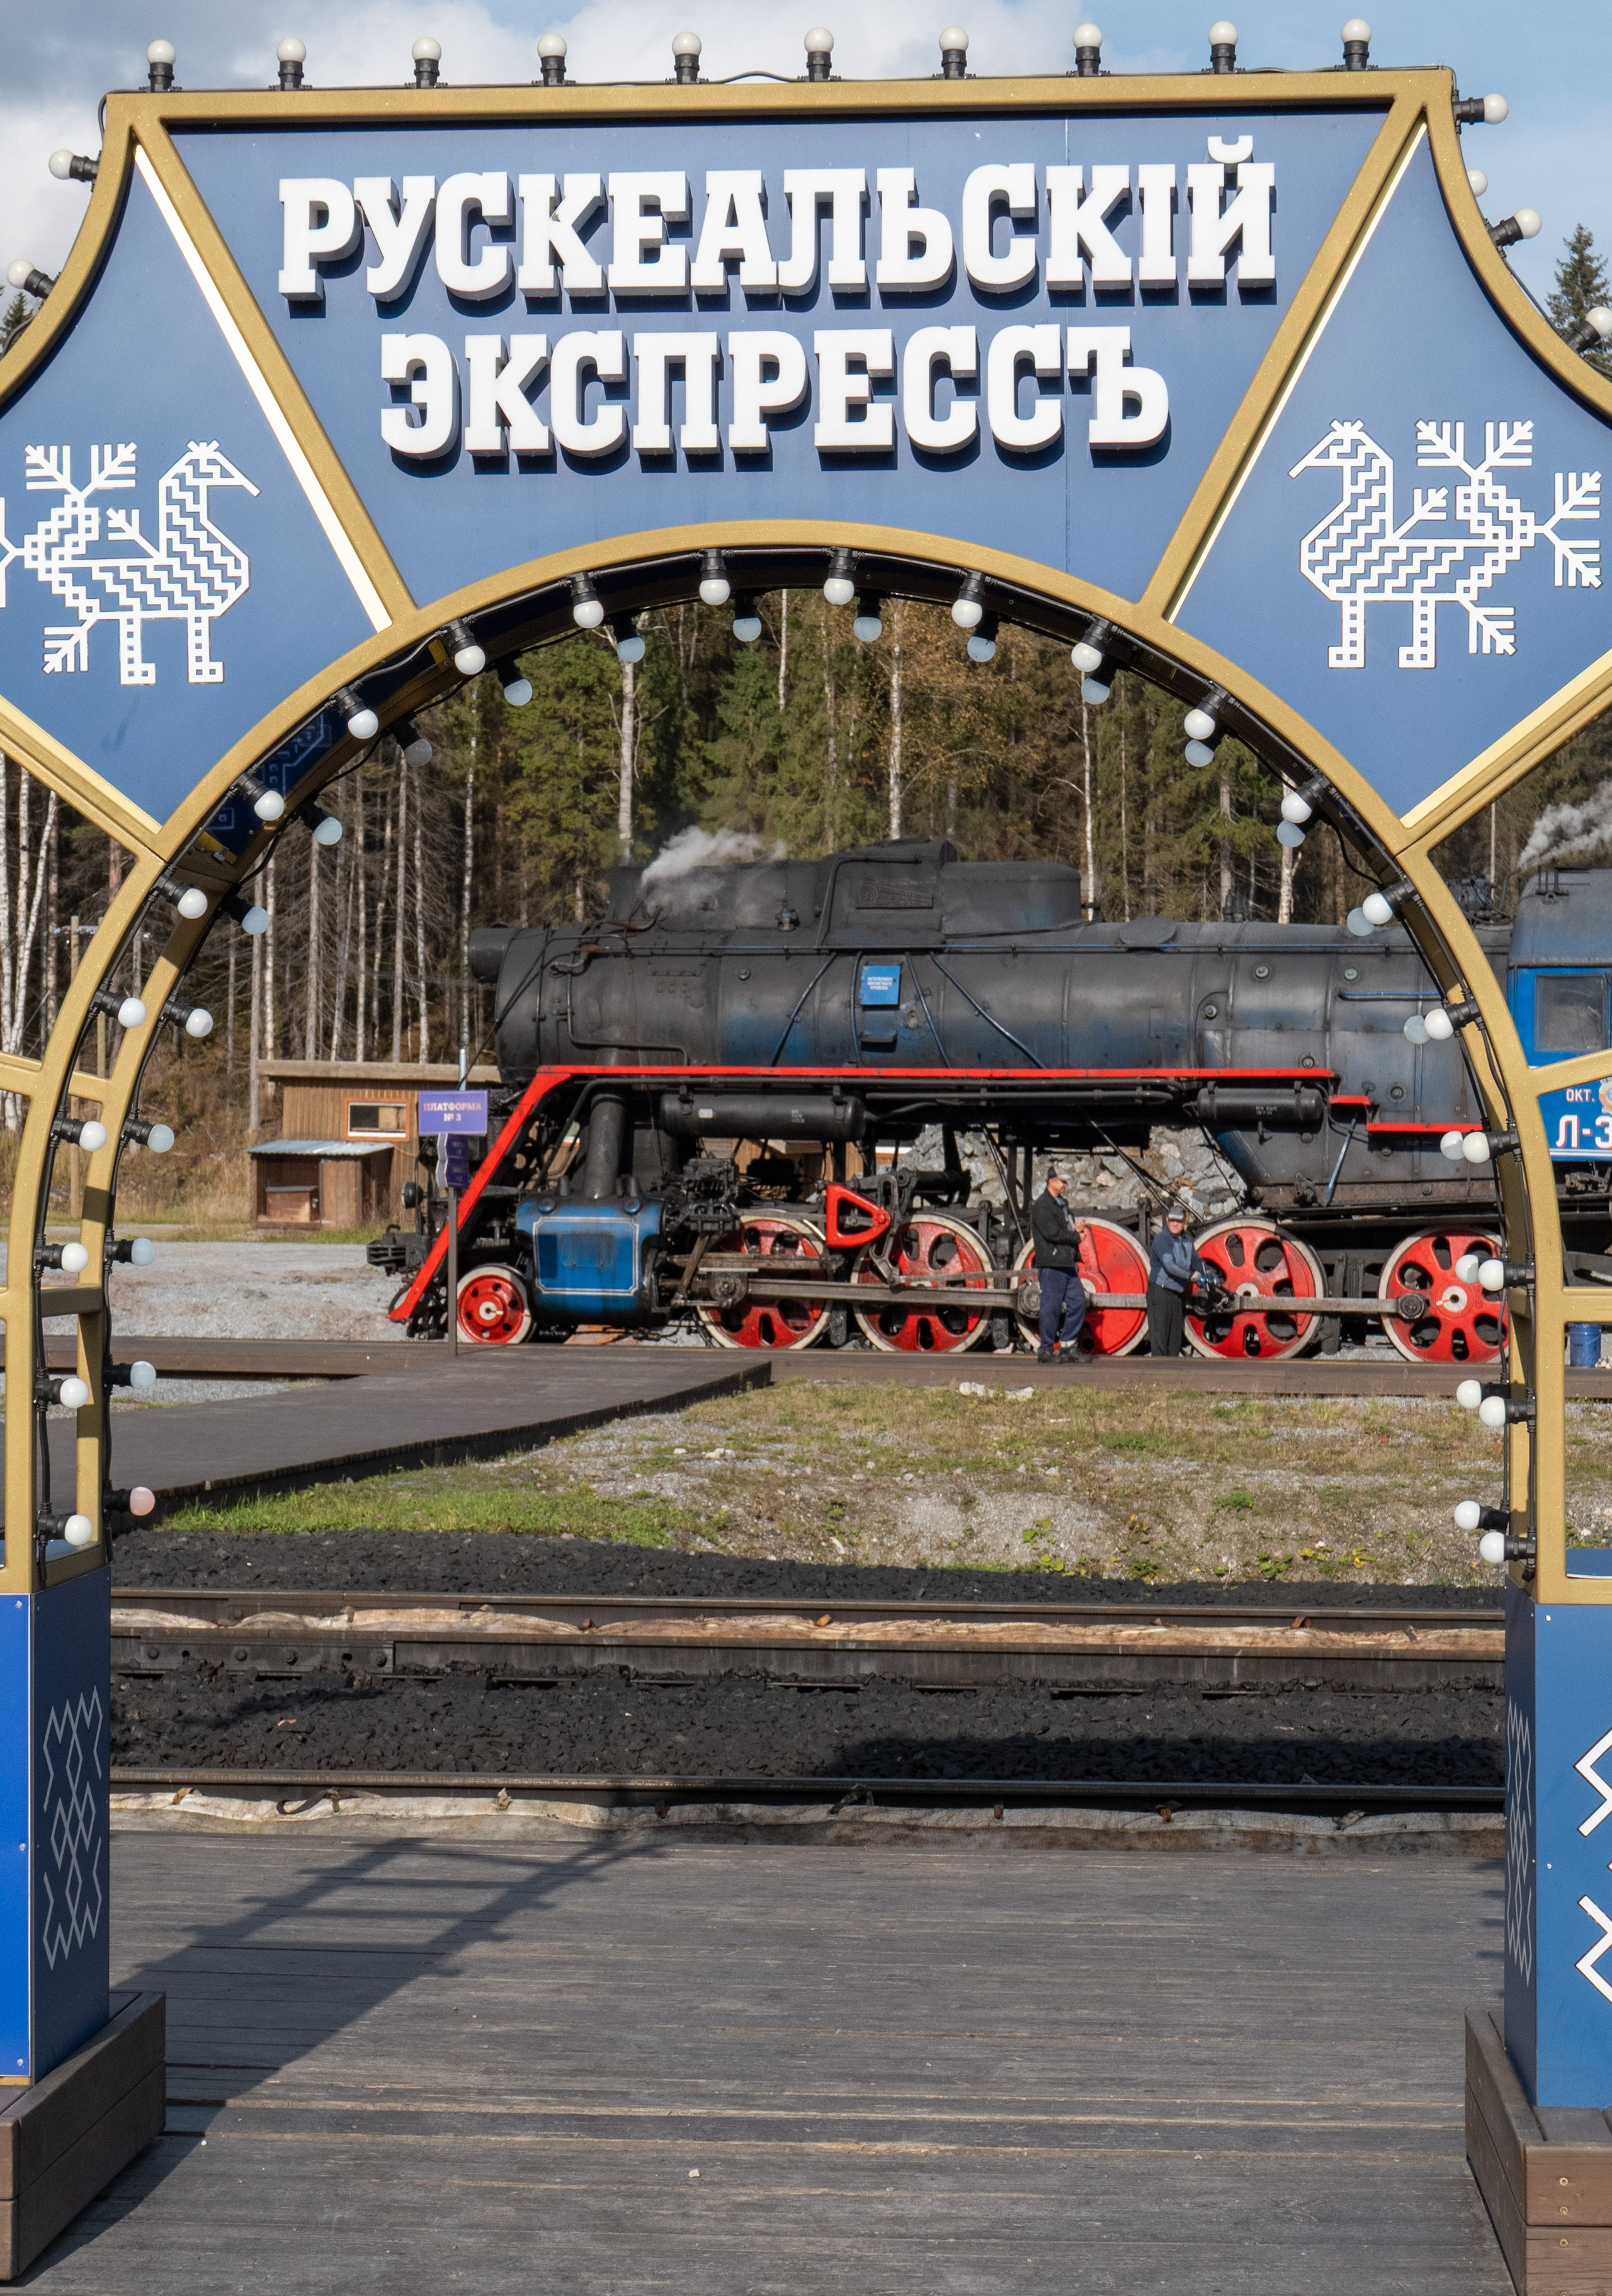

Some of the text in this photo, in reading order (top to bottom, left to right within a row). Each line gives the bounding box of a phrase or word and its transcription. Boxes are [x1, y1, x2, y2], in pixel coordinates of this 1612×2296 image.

[278, 135, 1276, 300] РУСКЕАЛЬСКІЙ
[380, 324, 1169, 457] ЭКСПРЕССЪ
[1566, 1088, 1596, 1102] ОКТ.
[423, 1102, 482, 1111] ПЛАТФОРМА
[456, 1113, 462, 1121] 3
